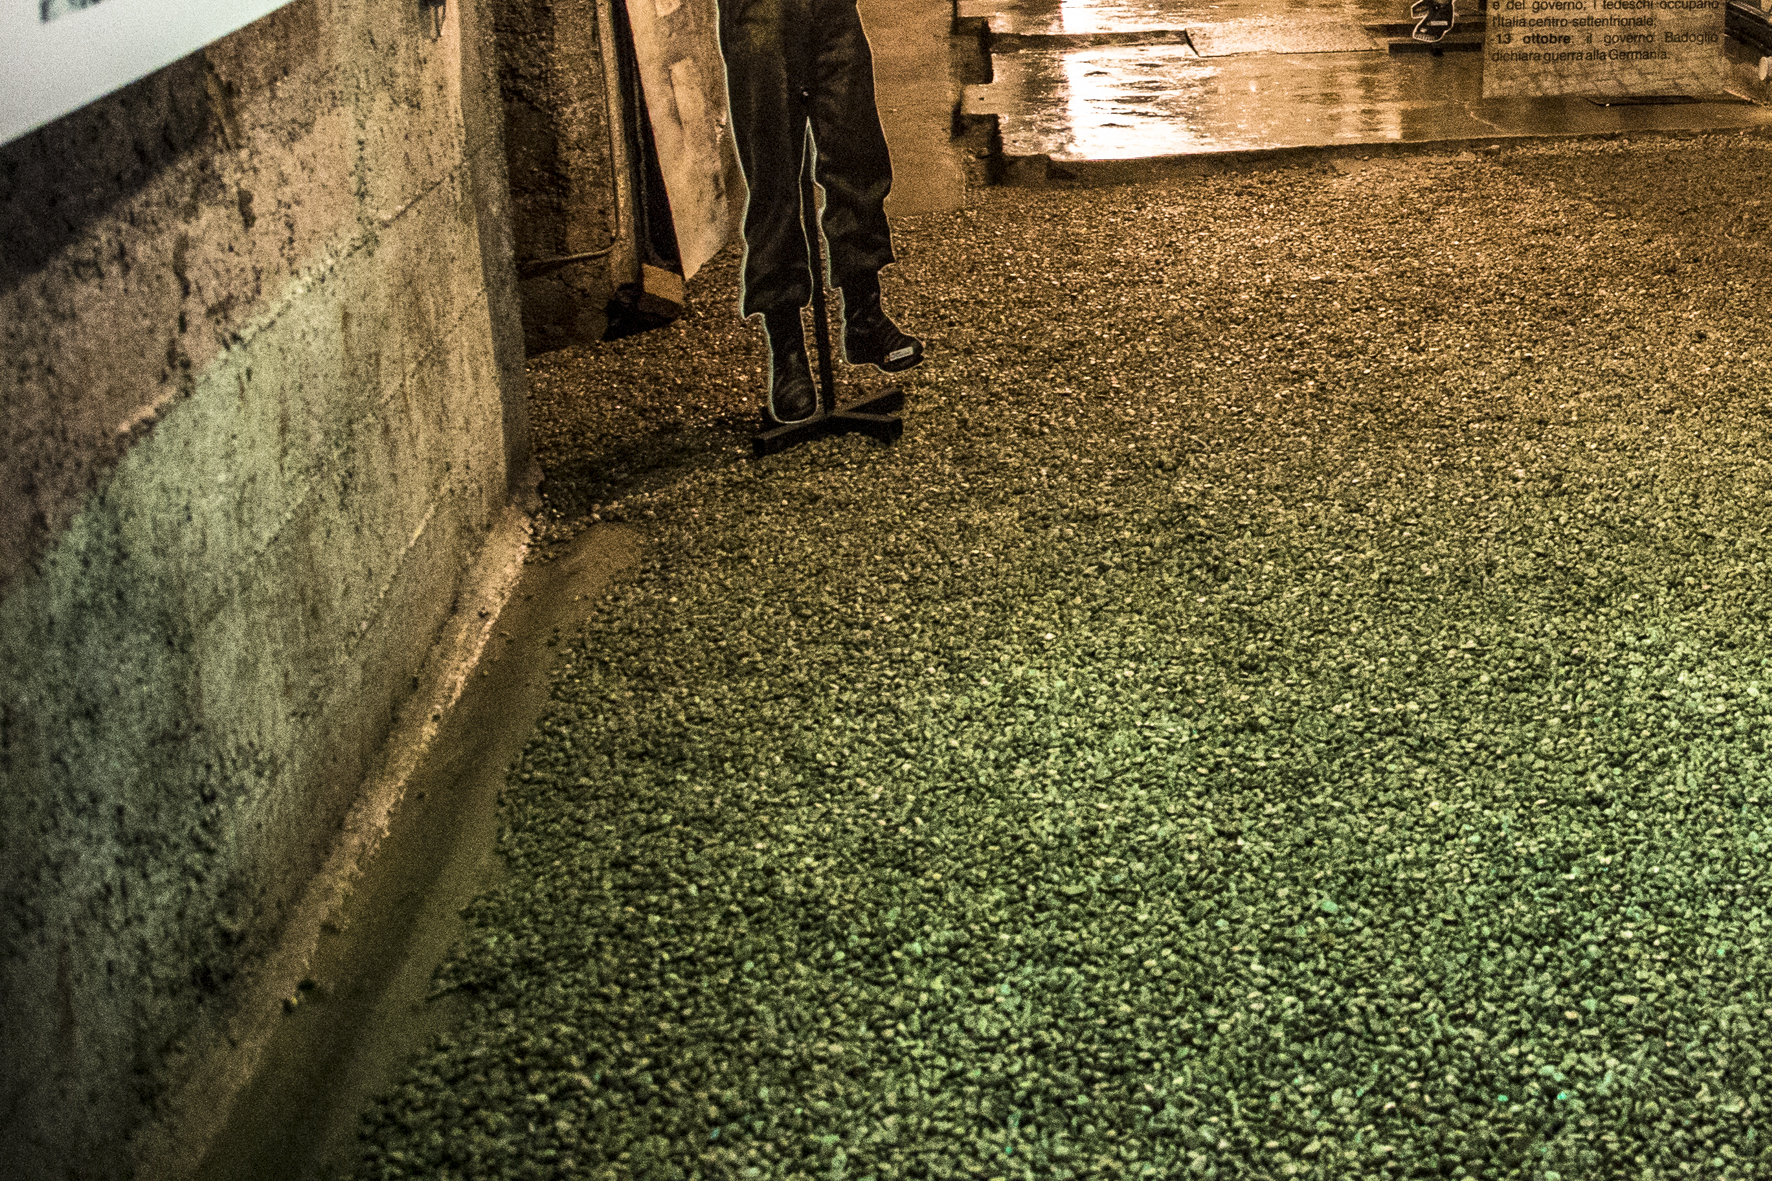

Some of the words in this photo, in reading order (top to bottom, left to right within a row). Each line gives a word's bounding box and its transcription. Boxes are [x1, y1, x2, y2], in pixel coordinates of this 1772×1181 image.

[1492, 1, 1500, 10] e
[1506, 0, 1525, 10] del
[1603, 0, 1653, 10] tedeschi
[1659, 0, 1719, 11] occupano
[1492, 16, 1526, 27] l'Italia
[1522, 33, 1575, 45] ottobre:
[1585, 34, 1592, 44] il
[1603, 34, 1654, 46] governo
[1664, 32, 1719, 45] Badoglio
[1492, 50, 1540, 62] dichiara
[1543, 51, 1583, 63] guerra
[1585, 49, 1605, 60] alla
[1608, 49, 1671, 60] Germania.
